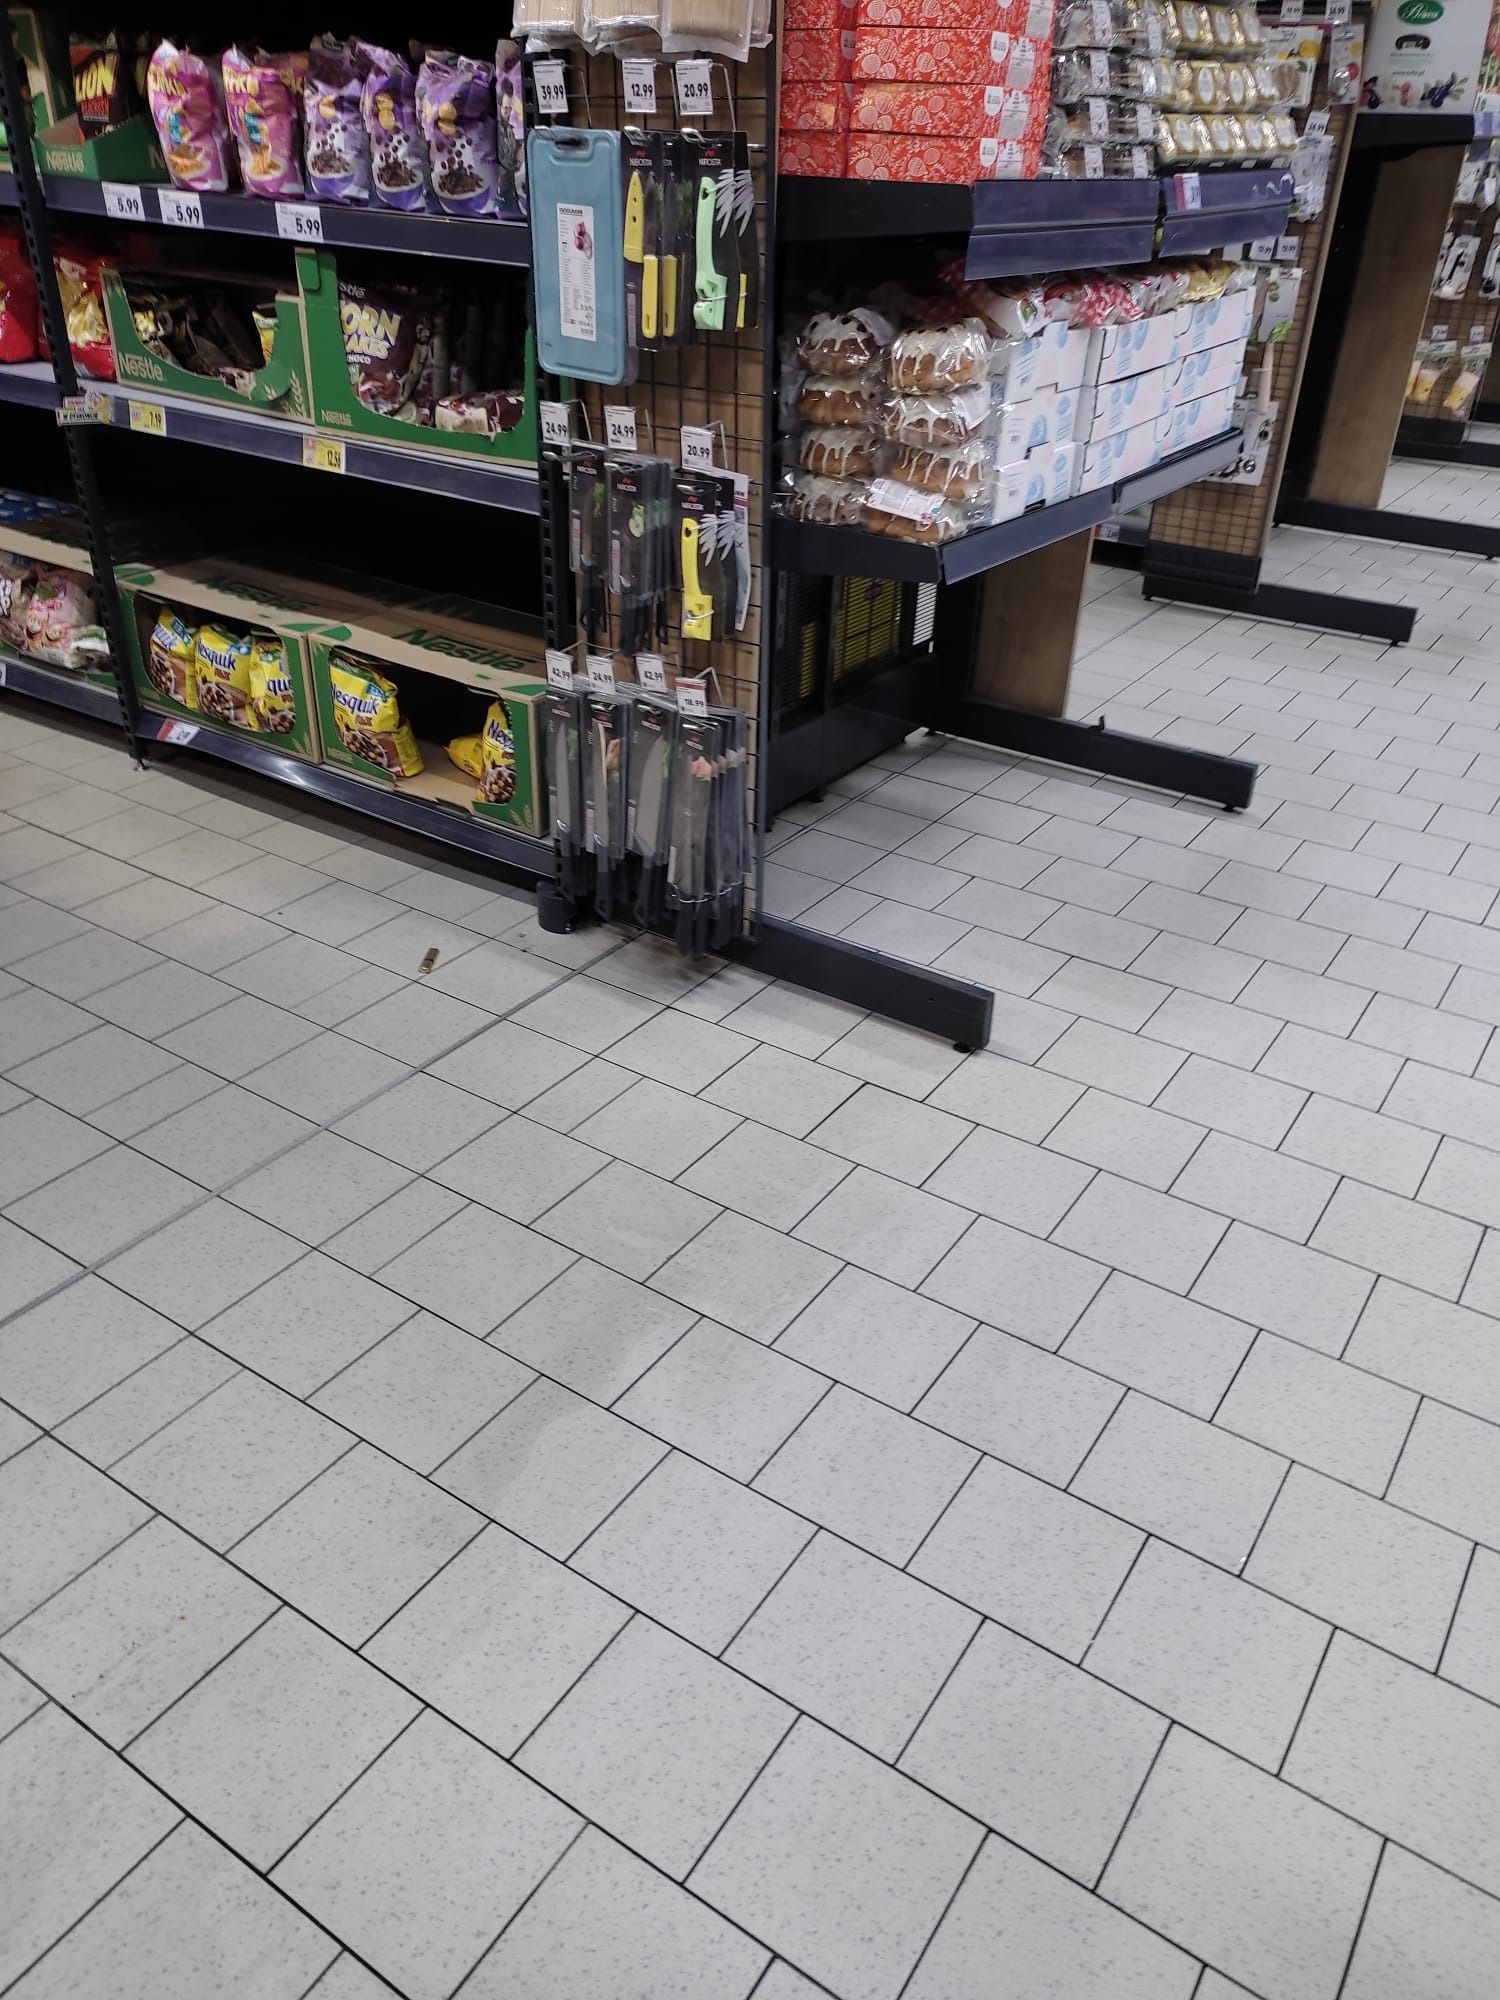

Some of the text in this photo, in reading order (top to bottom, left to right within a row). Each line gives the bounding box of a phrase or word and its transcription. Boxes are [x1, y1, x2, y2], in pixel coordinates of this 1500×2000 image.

[75, 52, 118, 102] LION
[540, 83, 564, 100] 39.99
[631, 82, 653, 98] 12.99
[684, 82, 709, 98] 20.99
[117, 197, 140, 215] 5.99
[175, 204, 201, 225] 5.99
[295, 217, 321, 236] 5.99
[340, 299, 402, 347] ORN
[344, 333, 391, 360] AKES
[546, 421, 568, 436] 24.99
[611, 423, 635, 439] 24.99
[687, 444, 711, 459] 20.99
